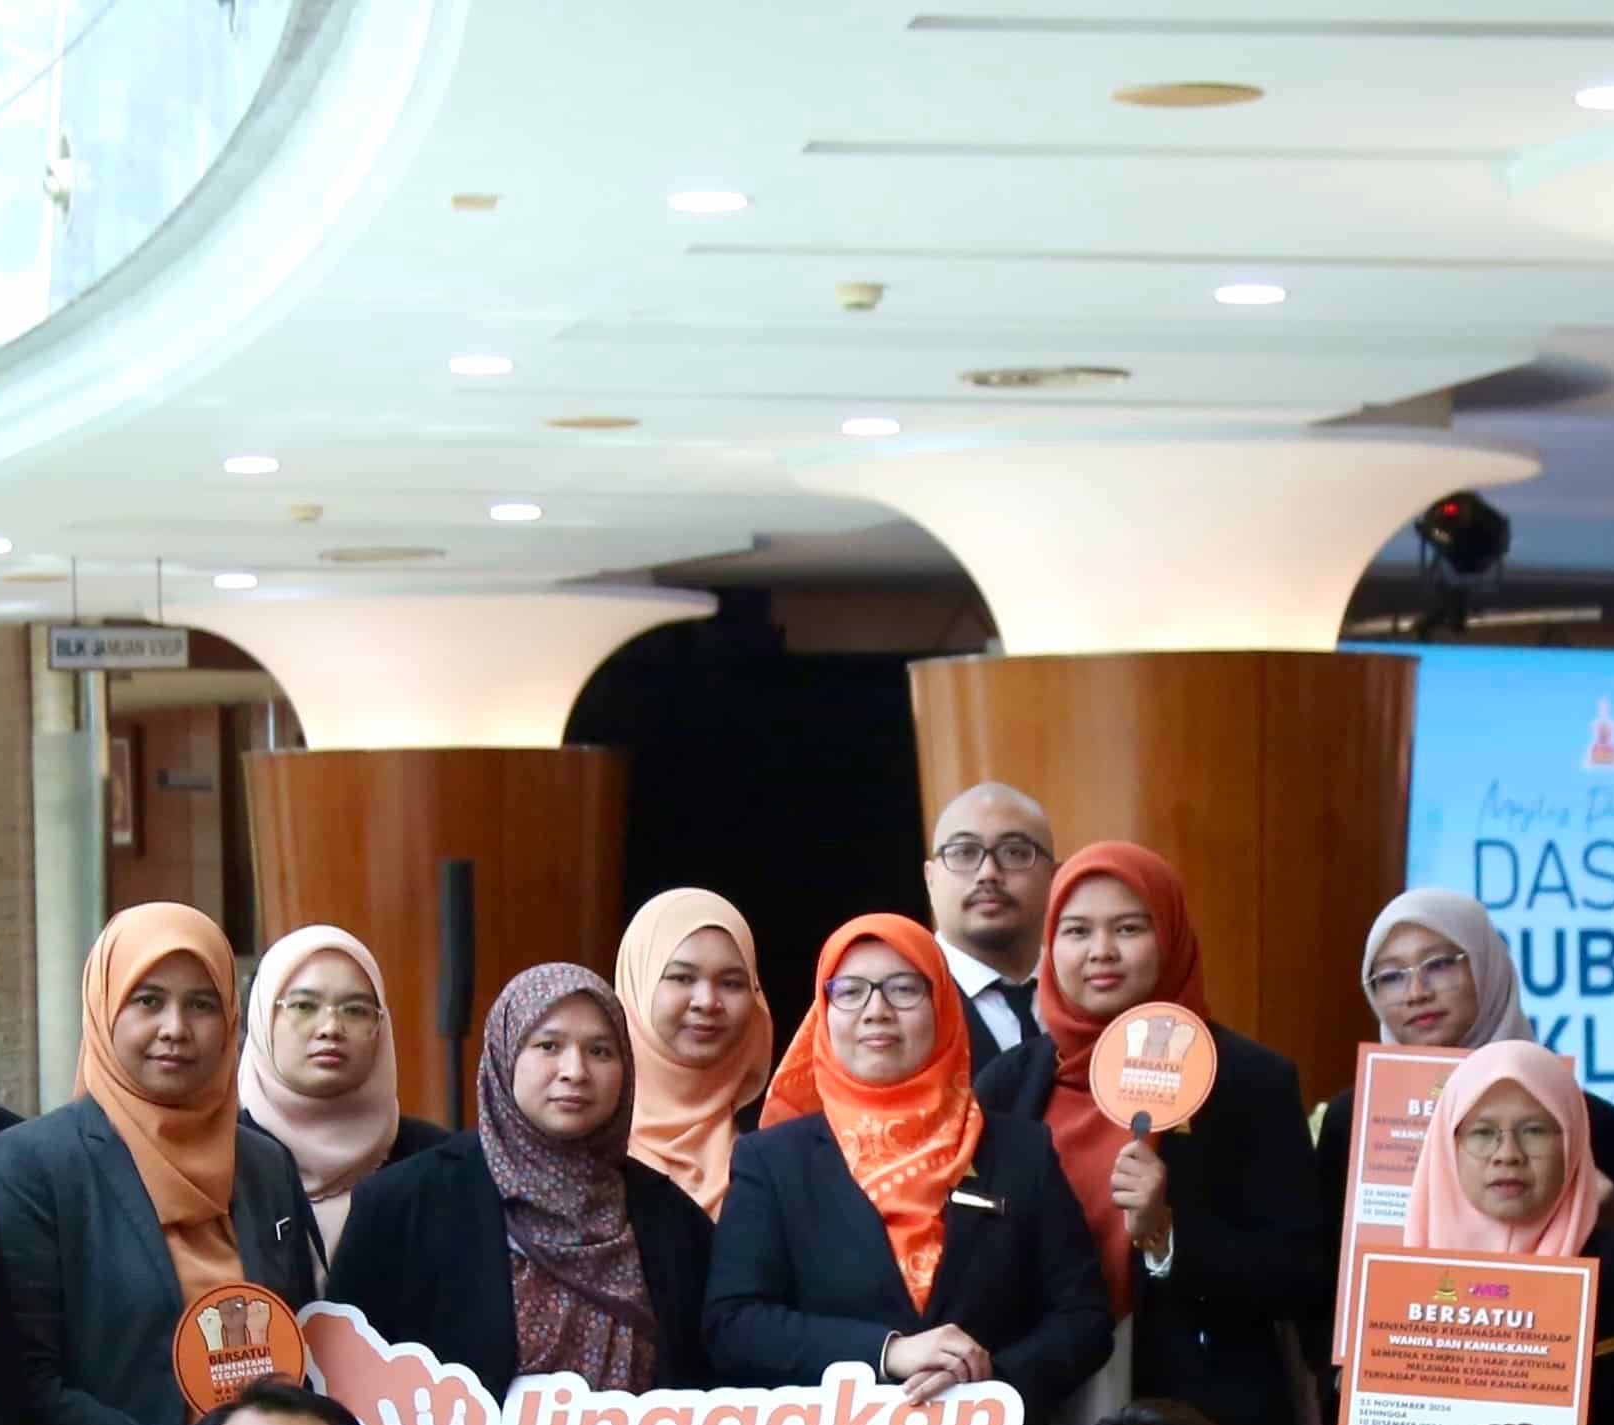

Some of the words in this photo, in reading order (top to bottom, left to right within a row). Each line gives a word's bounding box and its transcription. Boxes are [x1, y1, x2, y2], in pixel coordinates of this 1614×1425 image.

[1408, 1303, 1535, 1329] BERSATU!
[1369, 1321, 1438, 1335] MENENTANG
[1441, 1326, 1512, 1340] KEGANASAN
[1515, 1331, 1572, 1344] TERHADAP
[1388, 1334, 1434, 1348] WANITA
[1436, 1338, 1463, 1350] DAN
[1464, 1340, 1549, 1355] KANAK-KANAK
[209, 1347, 271, 1366] BERSATU!
[1363, 1370, 1417, 1382] TERHADAP
[1420, 1374, 1461, 1386] WANITA
[1490, 1380, 1570, 1393] KANAK-KANAK
[1463, 1366, 1529, 1380] KEGANASAN
